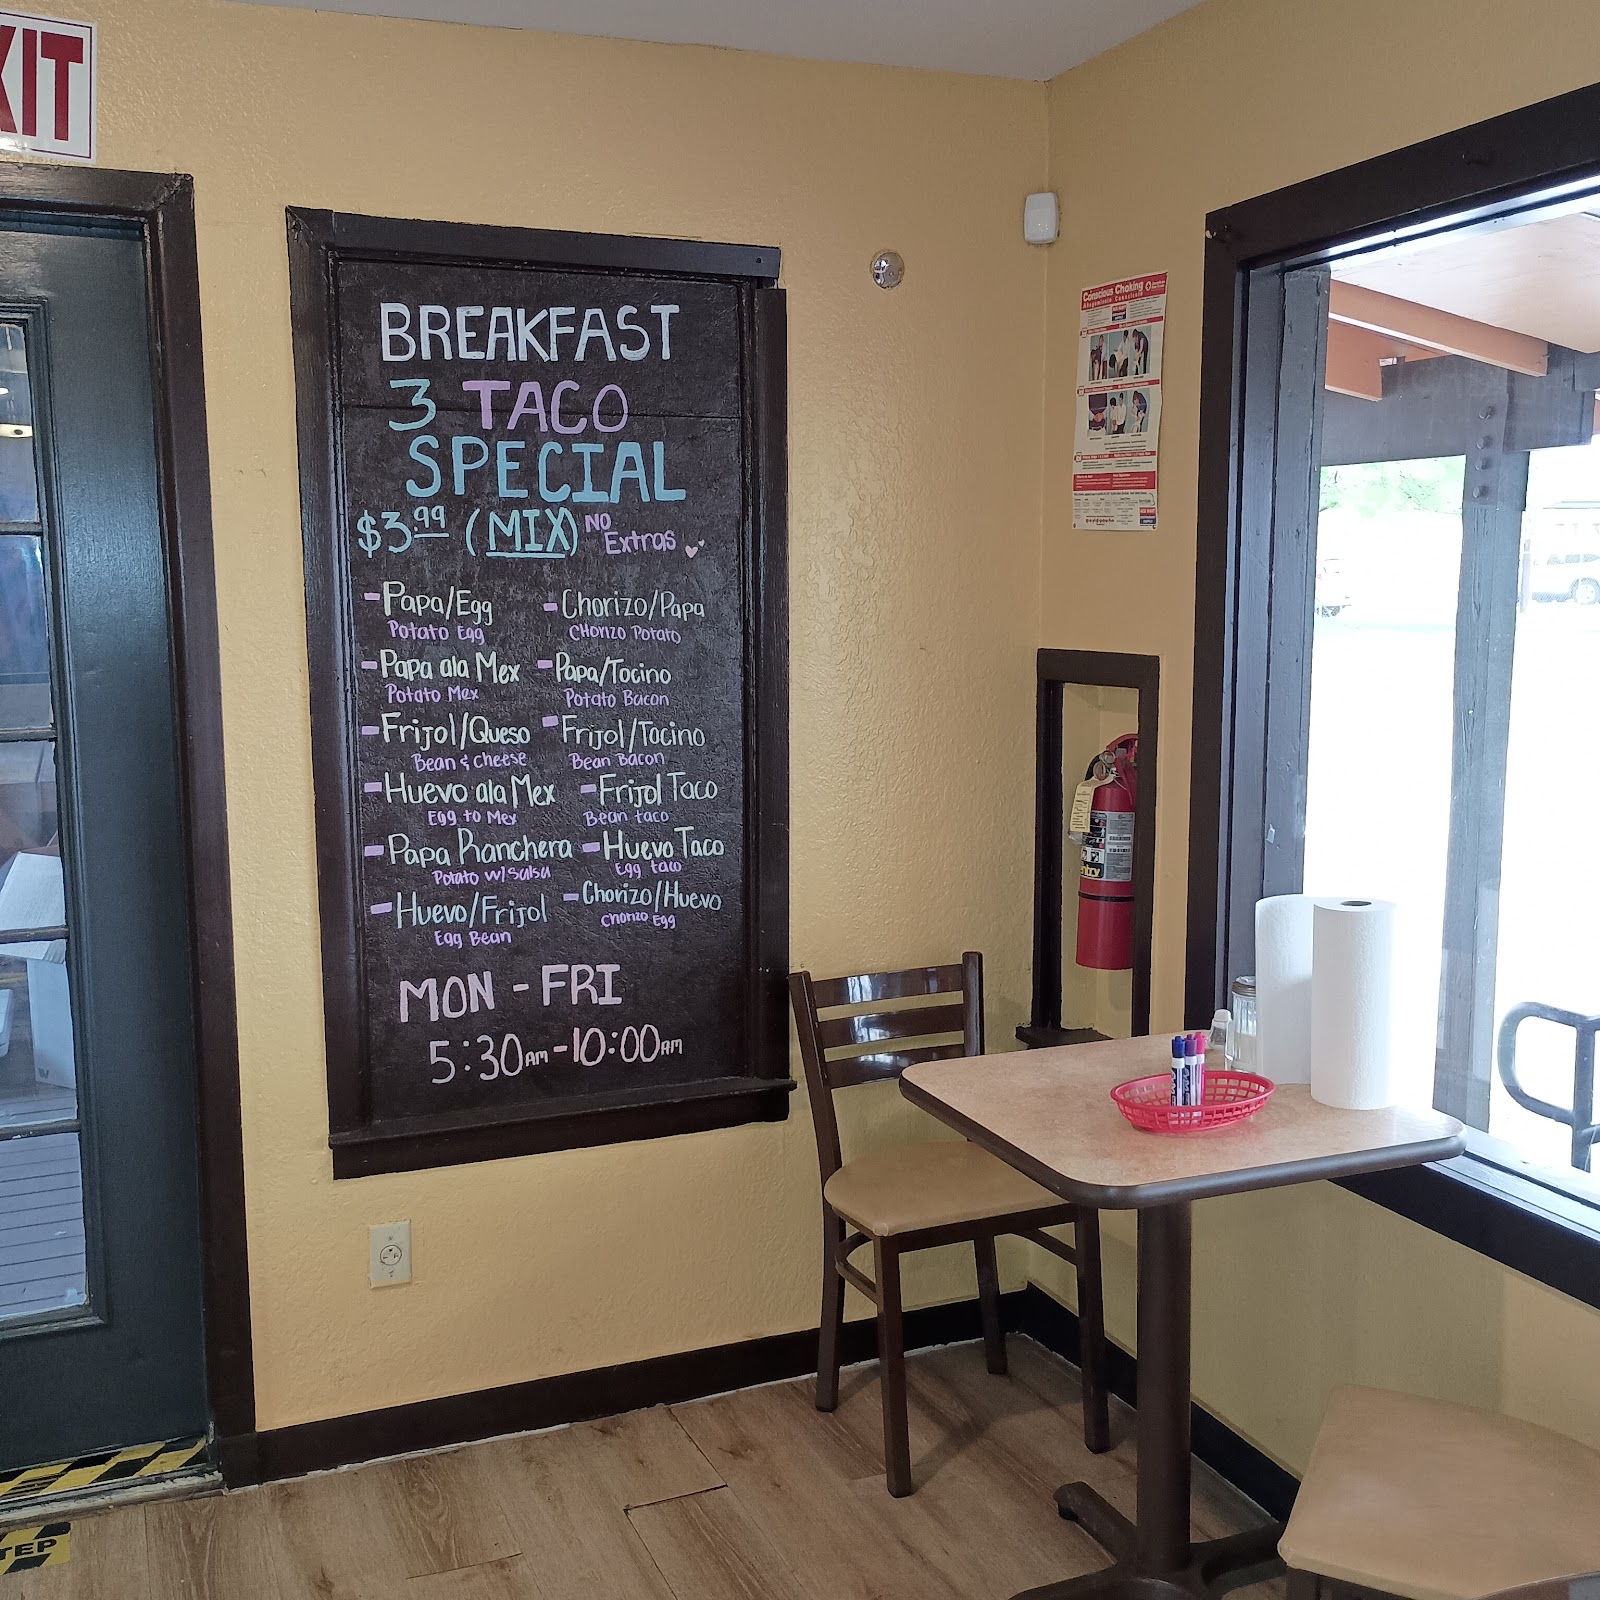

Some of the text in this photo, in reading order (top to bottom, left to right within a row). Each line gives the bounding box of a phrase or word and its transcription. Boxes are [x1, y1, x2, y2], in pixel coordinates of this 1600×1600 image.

[1083, 287, 1114, 302] Conscious
[1115, 281, 1144, 294] Choking
[381, 303, 679, 362] BREAKFAST
[389, 379, 628, 434] 3 TACO
[406, 435, 686, 503] SPECIAL
[585, 513, 611, 532] NO
[604, 530, 676, 554] Extras
[383, 581, 493, 625] Papa/Egg
[563, 589, 704, 621] Chorizo/Papa
[388, 620, 484, 645] Potato Egg
[631, 625, 681, 644] Potato
[380, 649, 433, 681] Papa
[476, 651, 520, 684] Mex
[556, 652, 671, 686] Papa/Tocino
[385, 683, 479, 703] Potato Mex
[564, 688, 669, 708] Potato Bacon
[411, 754, 456, 772] Bean
[568, 753, 665, 770] Bean Bacon
[385, 772, 468, 803] Huevo
[511, 774, 555, 808] Mex
[667, 772, 717, 801] Taco
[428, 811, 456, 826] Egg
[487, 810, 517, 825] Mex
[583, 810, 669, 826] Bean taco
[388, 828, 572, 868] Papa Ranchera
[603, 826, 724, 860] Huevo Taco
[432, 870, 479, 886] Potato
[615, 860, 681, 878] Egg taco
[583, 881, 721, 912] Chorizo/Huevo
[653, 915, 675, 929] Egg
[435, 930, 511, 948] Egg Bean
[400, 971, 494, 1022] MON
[542, 964, 622, 1006] FRI
